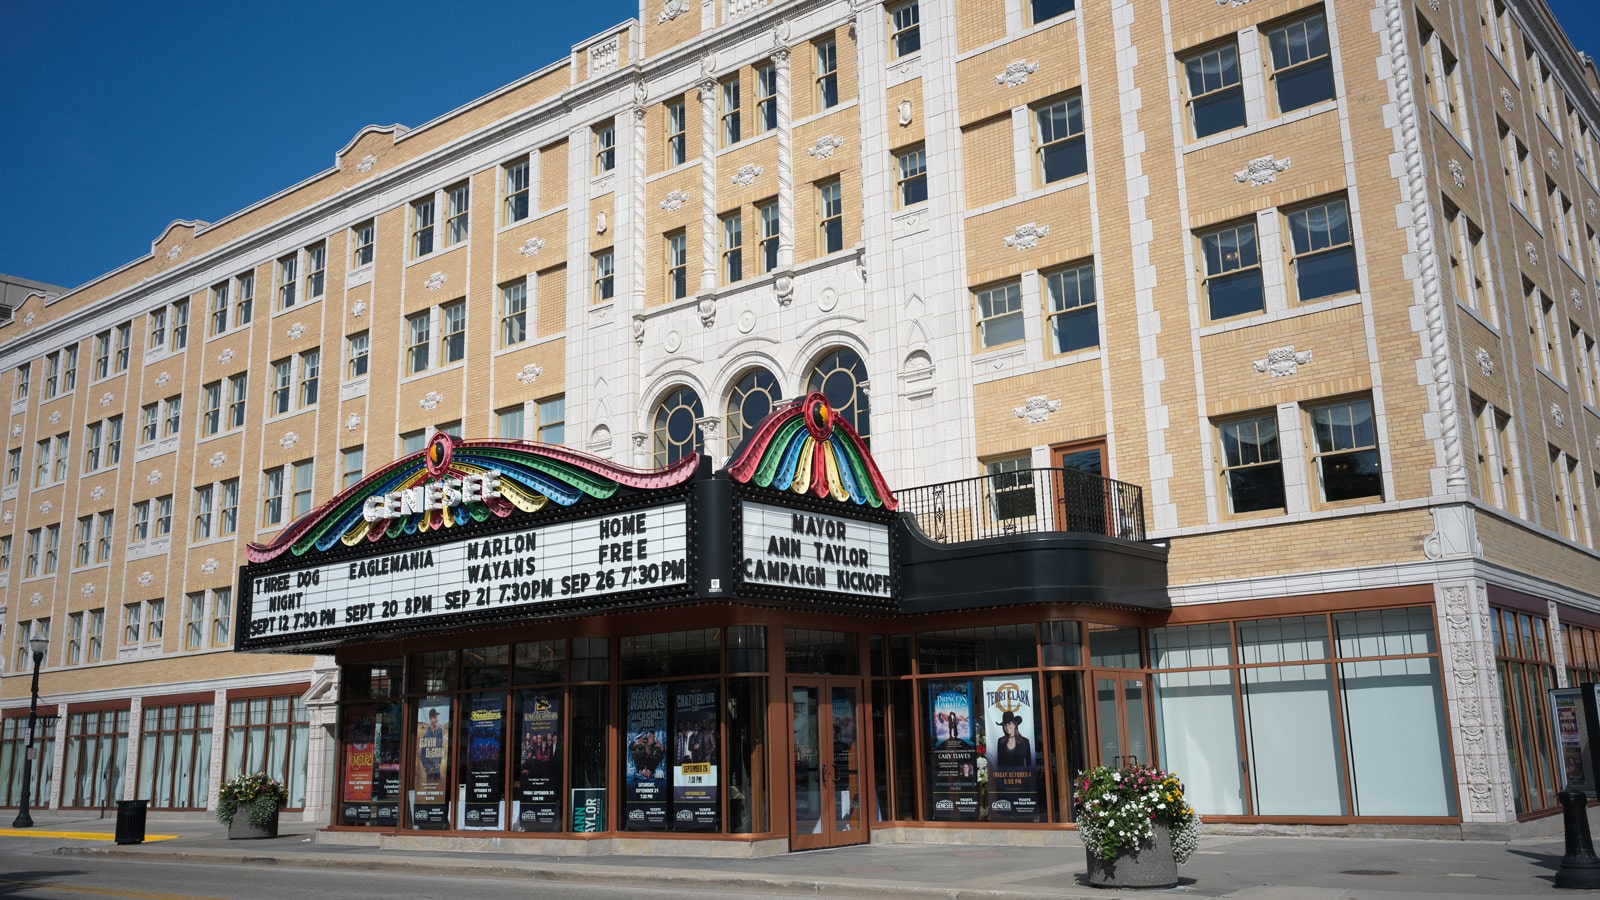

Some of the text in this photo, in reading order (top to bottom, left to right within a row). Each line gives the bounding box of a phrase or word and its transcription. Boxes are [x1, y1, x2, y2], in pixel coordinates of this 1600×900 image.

[363, 469, 501, 522] GENESEE
[599, 513, 646, 540] HOME
[792, 513, 846, 541] MAYOR
[467, 532, 536, 560] MARLON
[599, 539, 648, 565] FREE
[767, 535, 868, 568] ANN TAYLOR
[350, 550, 434, 580] EAGLEMANIA
[467, 557, 536, 584] WAYANS
[743, 558, 891, 595] CAMPAIGN KICKOFF
[255, 569, 320, 595] THREE DOG
[561, 573, 590, 595] SEP
[596, 569, 615, 590] 26
[269, 592, 303, 613] NIGHT
[346, 602, 375, 623] SEPT
[382, 599, 398, 618] 20
[445, 589, 470, 610] SEP
[476, 586, 490, 606] 21
[250, 616, 276, 637] SEPT
[279, 614, 289, 631] 12
[630, 698, 665, 710] WAYANS
[631, 689, 664, 701] MARLON
[987, 689, 1031, 708] TERRI CLARK
[574, 807, 585, 832] ANN
[585, 798, 597, 832] AYLOR
